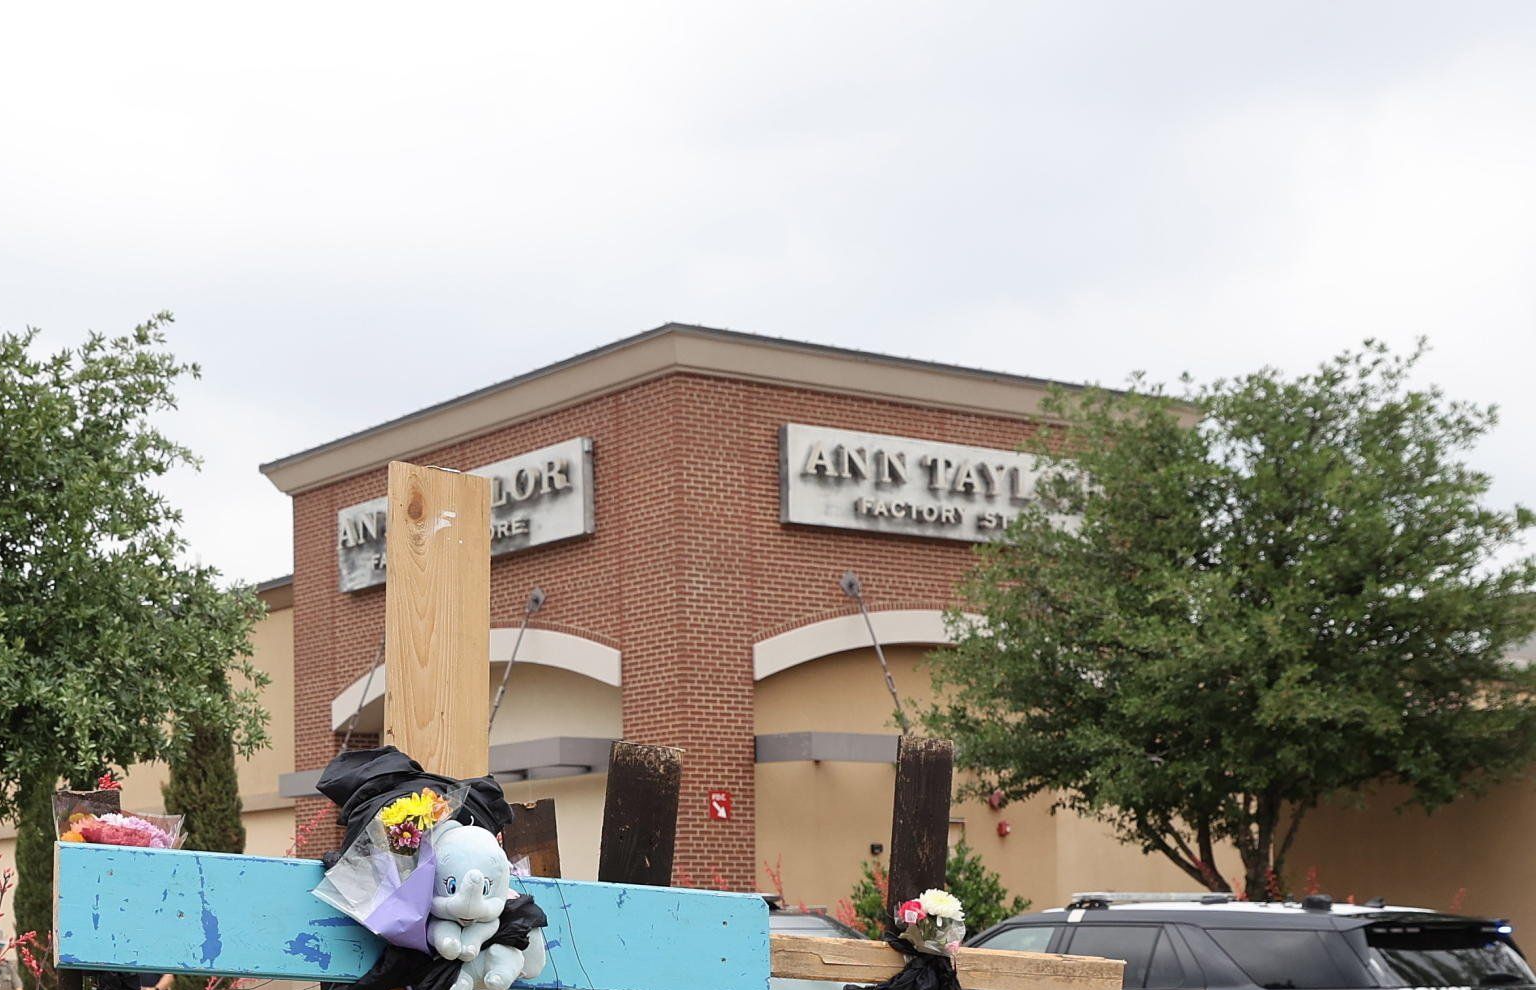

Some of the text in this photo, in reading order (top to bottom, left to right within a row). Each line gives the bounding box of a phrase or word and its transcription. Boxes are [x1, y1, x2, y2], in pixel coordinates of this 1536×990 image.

[801, 440, 1086, 504] ANN TAYL
[336, 511, 387, 549] AN
[857, 499, 965, 526] FACTORY
